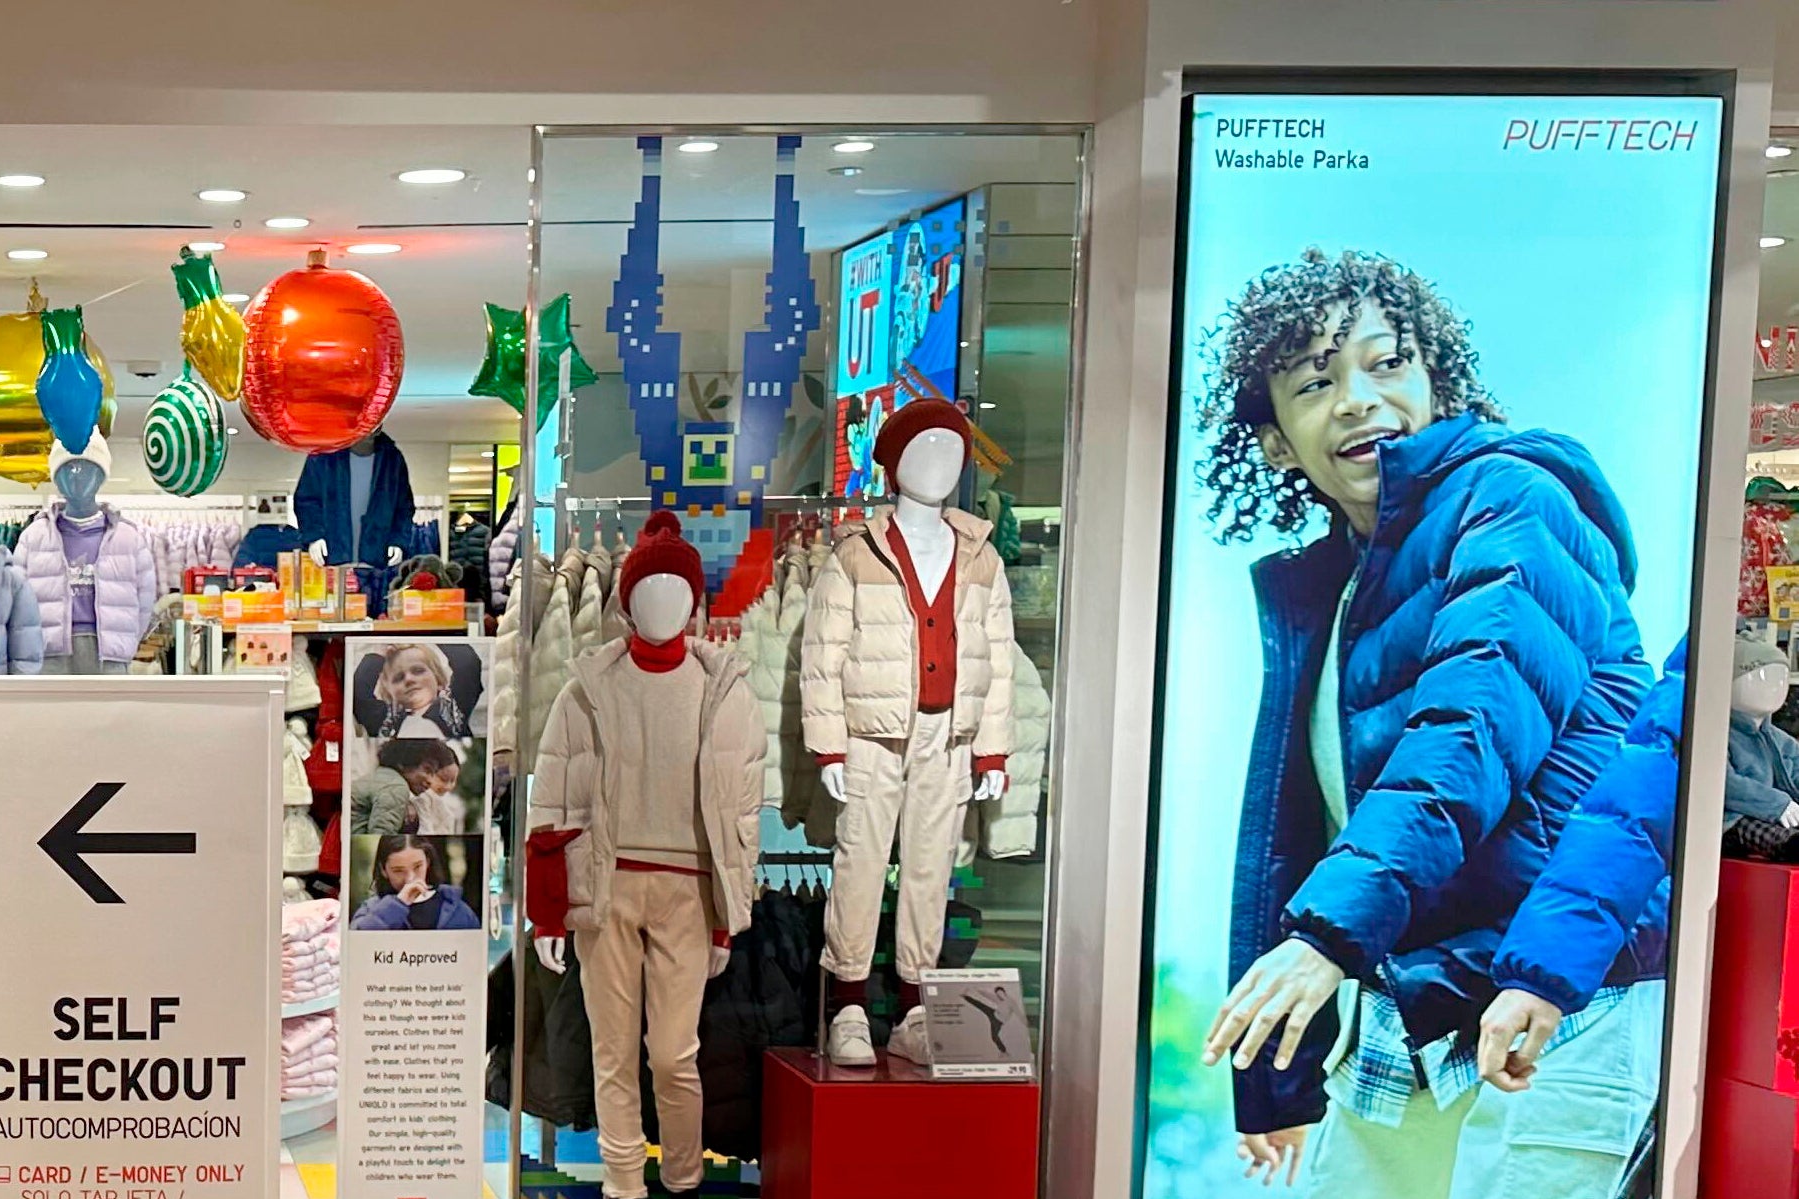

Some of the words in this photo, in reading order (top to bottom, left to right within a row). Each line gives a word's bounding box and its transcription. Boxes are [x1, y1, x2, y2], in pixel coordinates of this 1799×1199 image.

[1217, 118, 1325, 138] PUFFTECH
[1503, 119, 1698, 151] PUFFTECH
[1215, 149, 1304, 169] Washable
[1313, 149, 1369, 169] Parka
[847, 289, 880, 380] UT
[374, 951, 393, 963] Kid
[400, 951, 457, 966] Approved
[53, 997, 180, 1041] SELF
[18, 1165, 71, 1184] CARD
[79, 1166, 88, 1184] /
[96, 1165, 187, 1184] E-MONEY
[195, 1164, 245, 1182] ONLY
